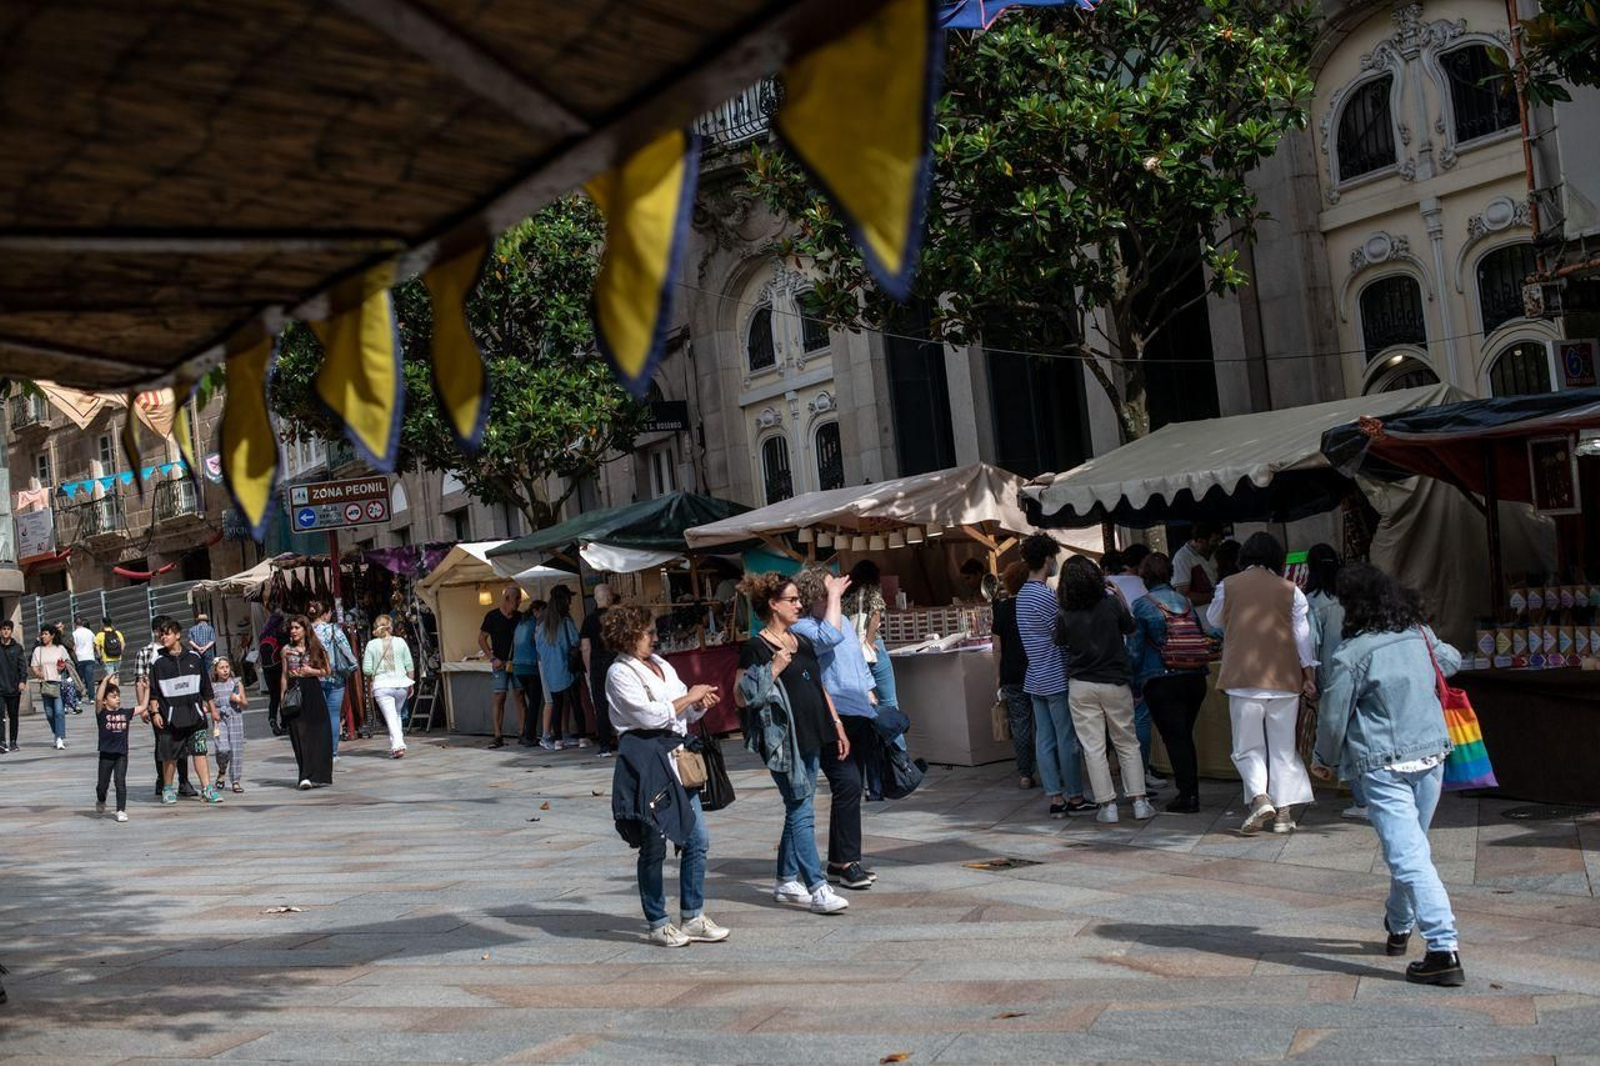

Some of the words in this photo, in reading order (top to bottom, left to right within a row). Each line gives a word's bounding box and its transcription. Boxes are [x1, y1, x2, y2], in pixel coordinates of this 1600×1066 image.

[313, 487, 343, 499] ZONA
[345, 482, 386, 495] PEONIL
[105, 721, 127, 731] OVER
